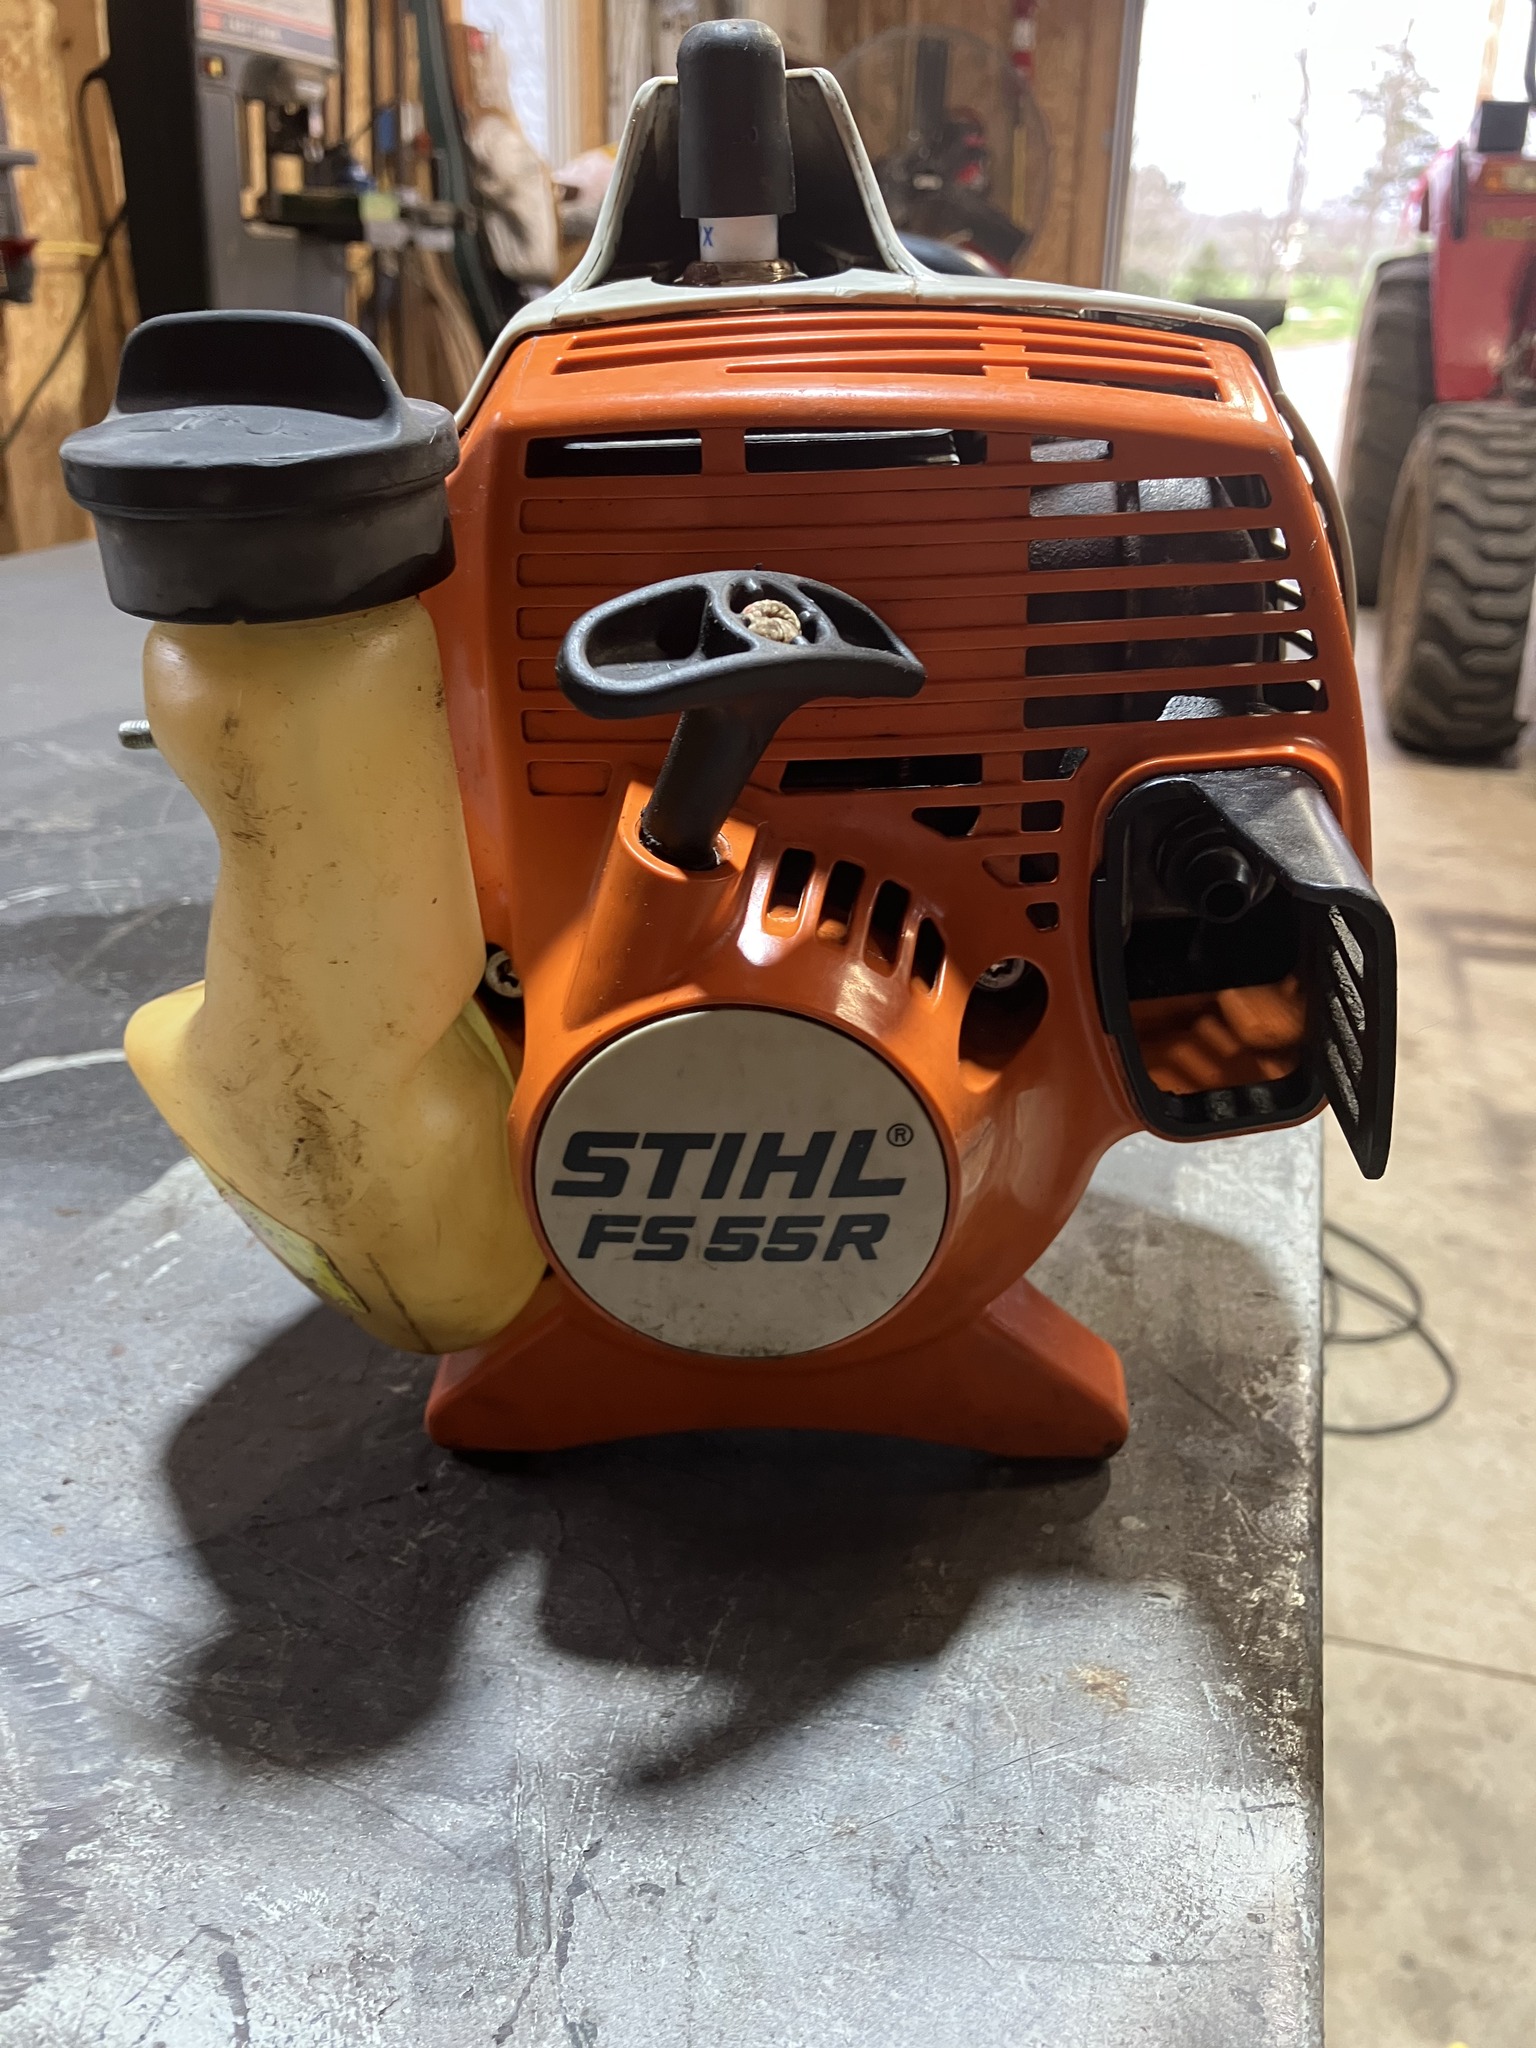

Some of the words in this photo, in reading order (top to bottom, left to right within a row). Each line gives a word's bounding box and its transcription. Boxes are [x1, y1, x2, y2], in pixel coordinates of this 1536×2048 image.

[551, 1129, 907, 1200] STIHL
[577, 1215, 697, 1262] FS
[703, 1213, 891, 1263] 55R
